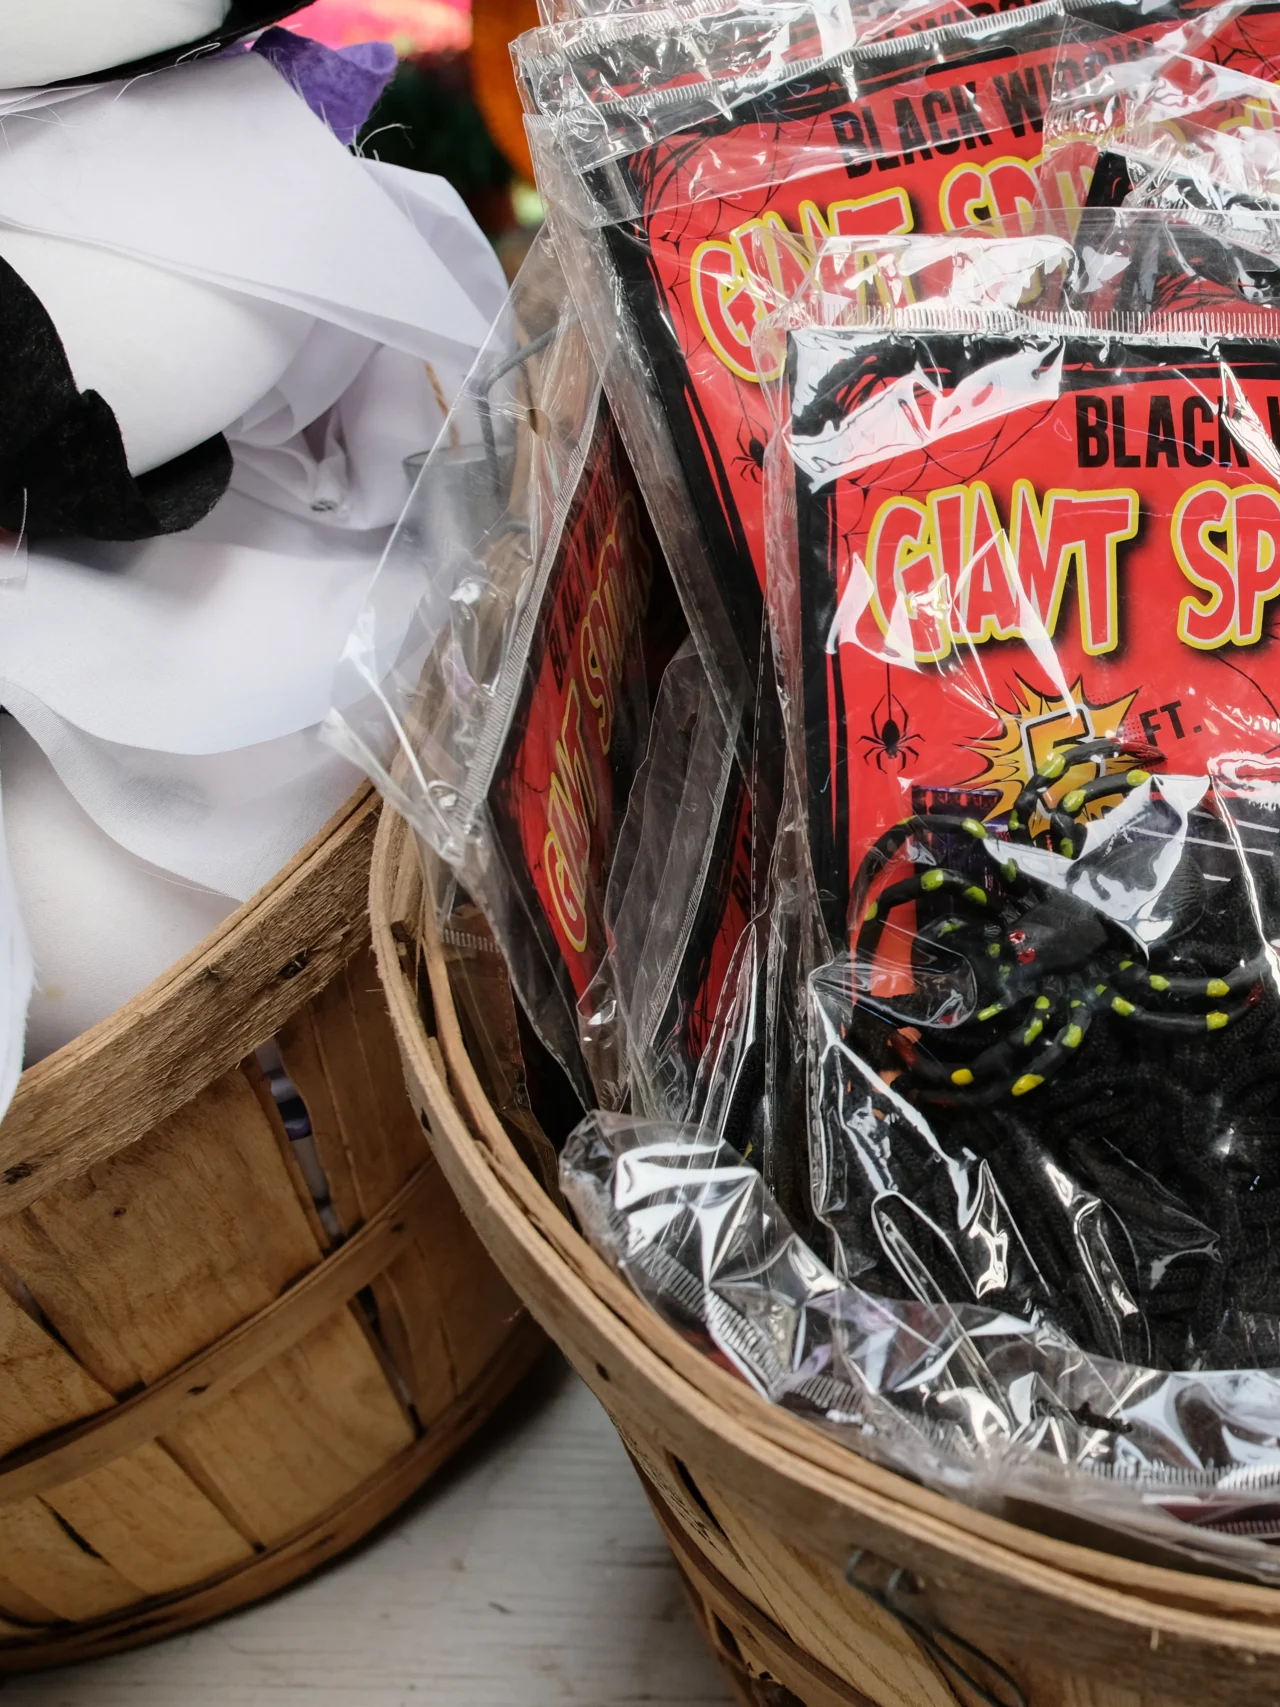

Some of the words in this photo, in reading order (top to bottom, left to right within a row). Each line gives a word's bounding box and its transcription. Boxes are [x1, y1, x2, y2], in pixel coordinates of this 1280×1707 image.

[831, 80, 992, 179] BLACK
[1075, 394, 1250, 469] BLACK
[864, 478, 1140, 663] GIANT
[1138, 699, 1203, 747] FT.
